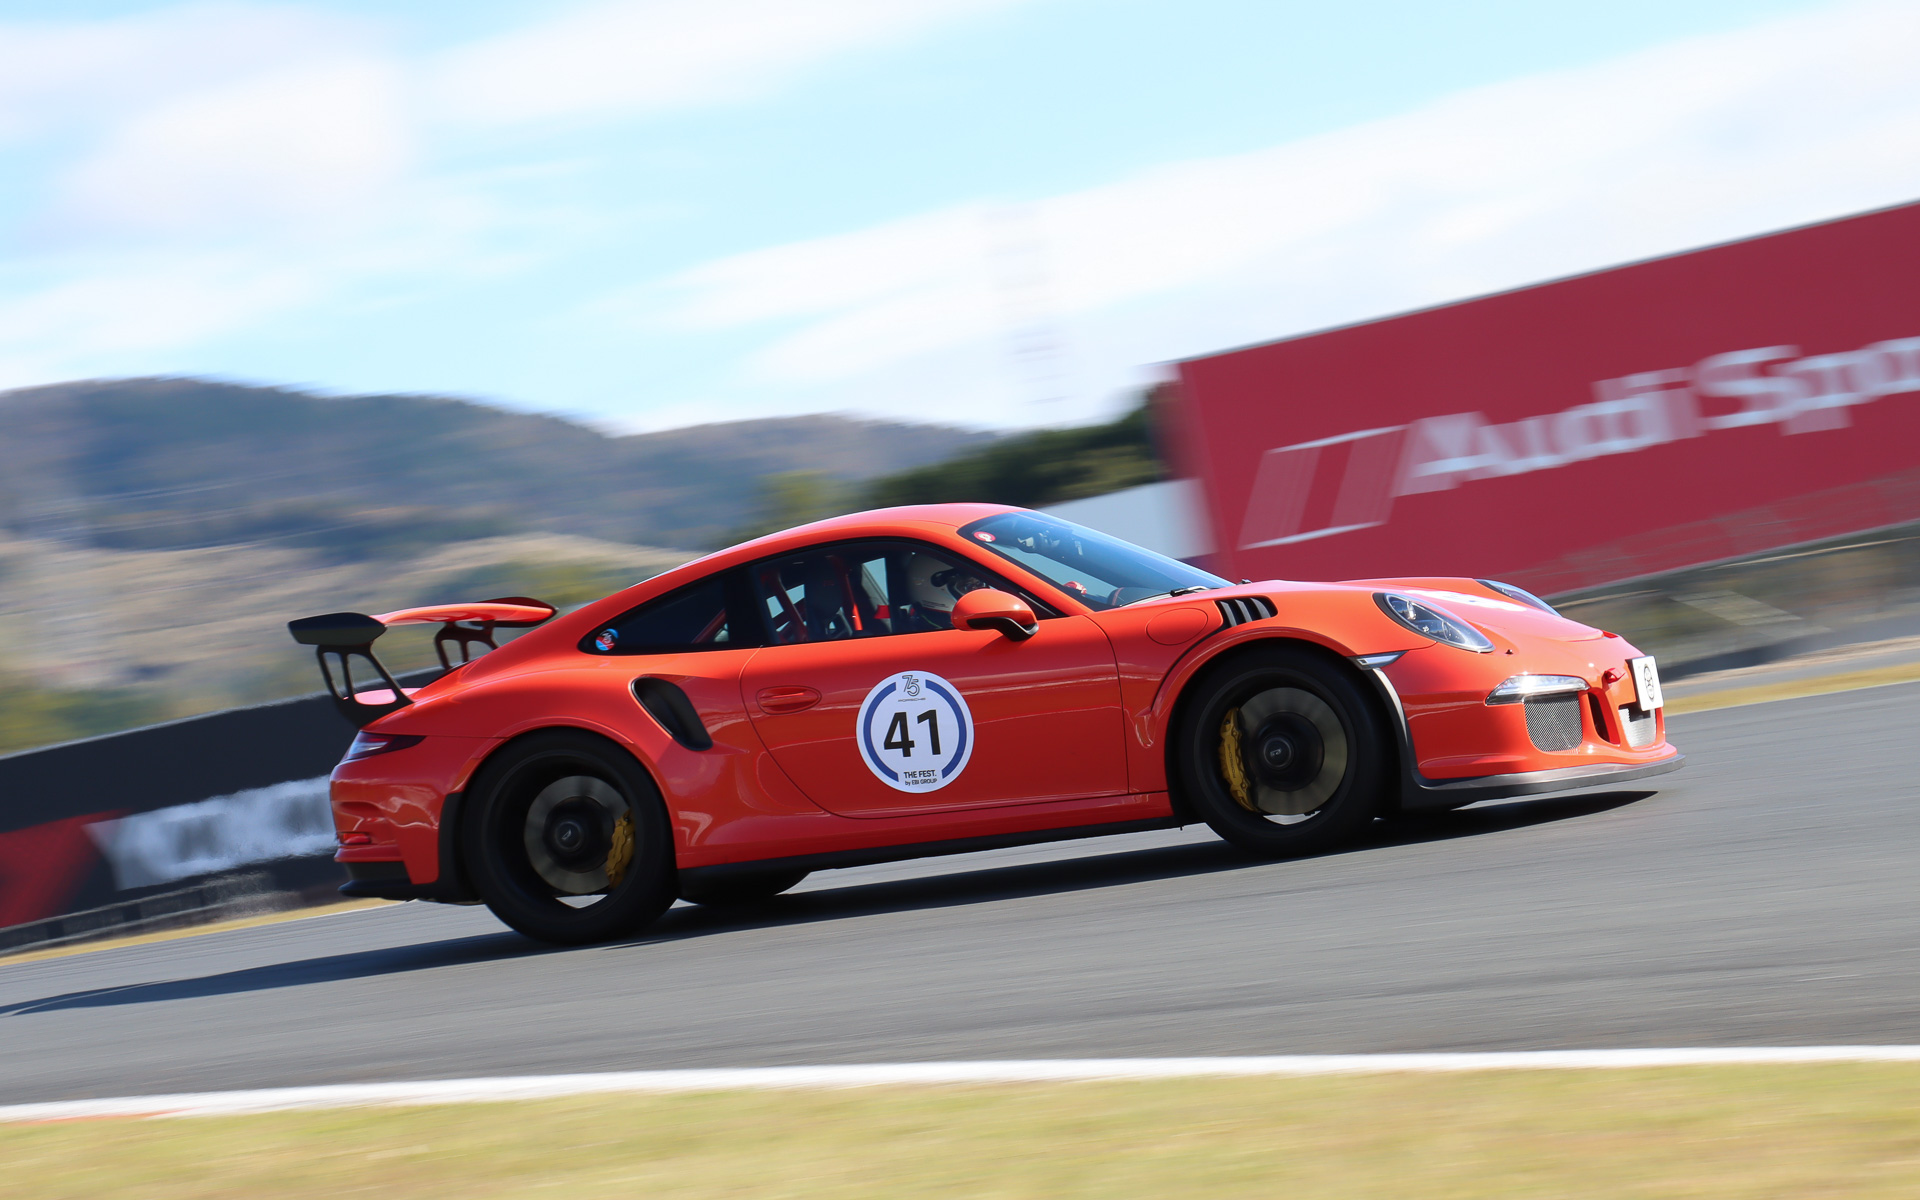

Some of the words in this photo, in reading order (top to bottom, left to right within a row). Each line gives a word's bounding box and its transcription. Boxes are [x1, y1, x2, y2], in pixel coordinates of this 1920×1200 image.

[1393, 366, 1706, 497] Audi
[902, 675, 920, 696] 75
[884, 709, 941, 757] 41
[904, 771, 918, 779] THE
[919, 769, 937, 778] FEST.
